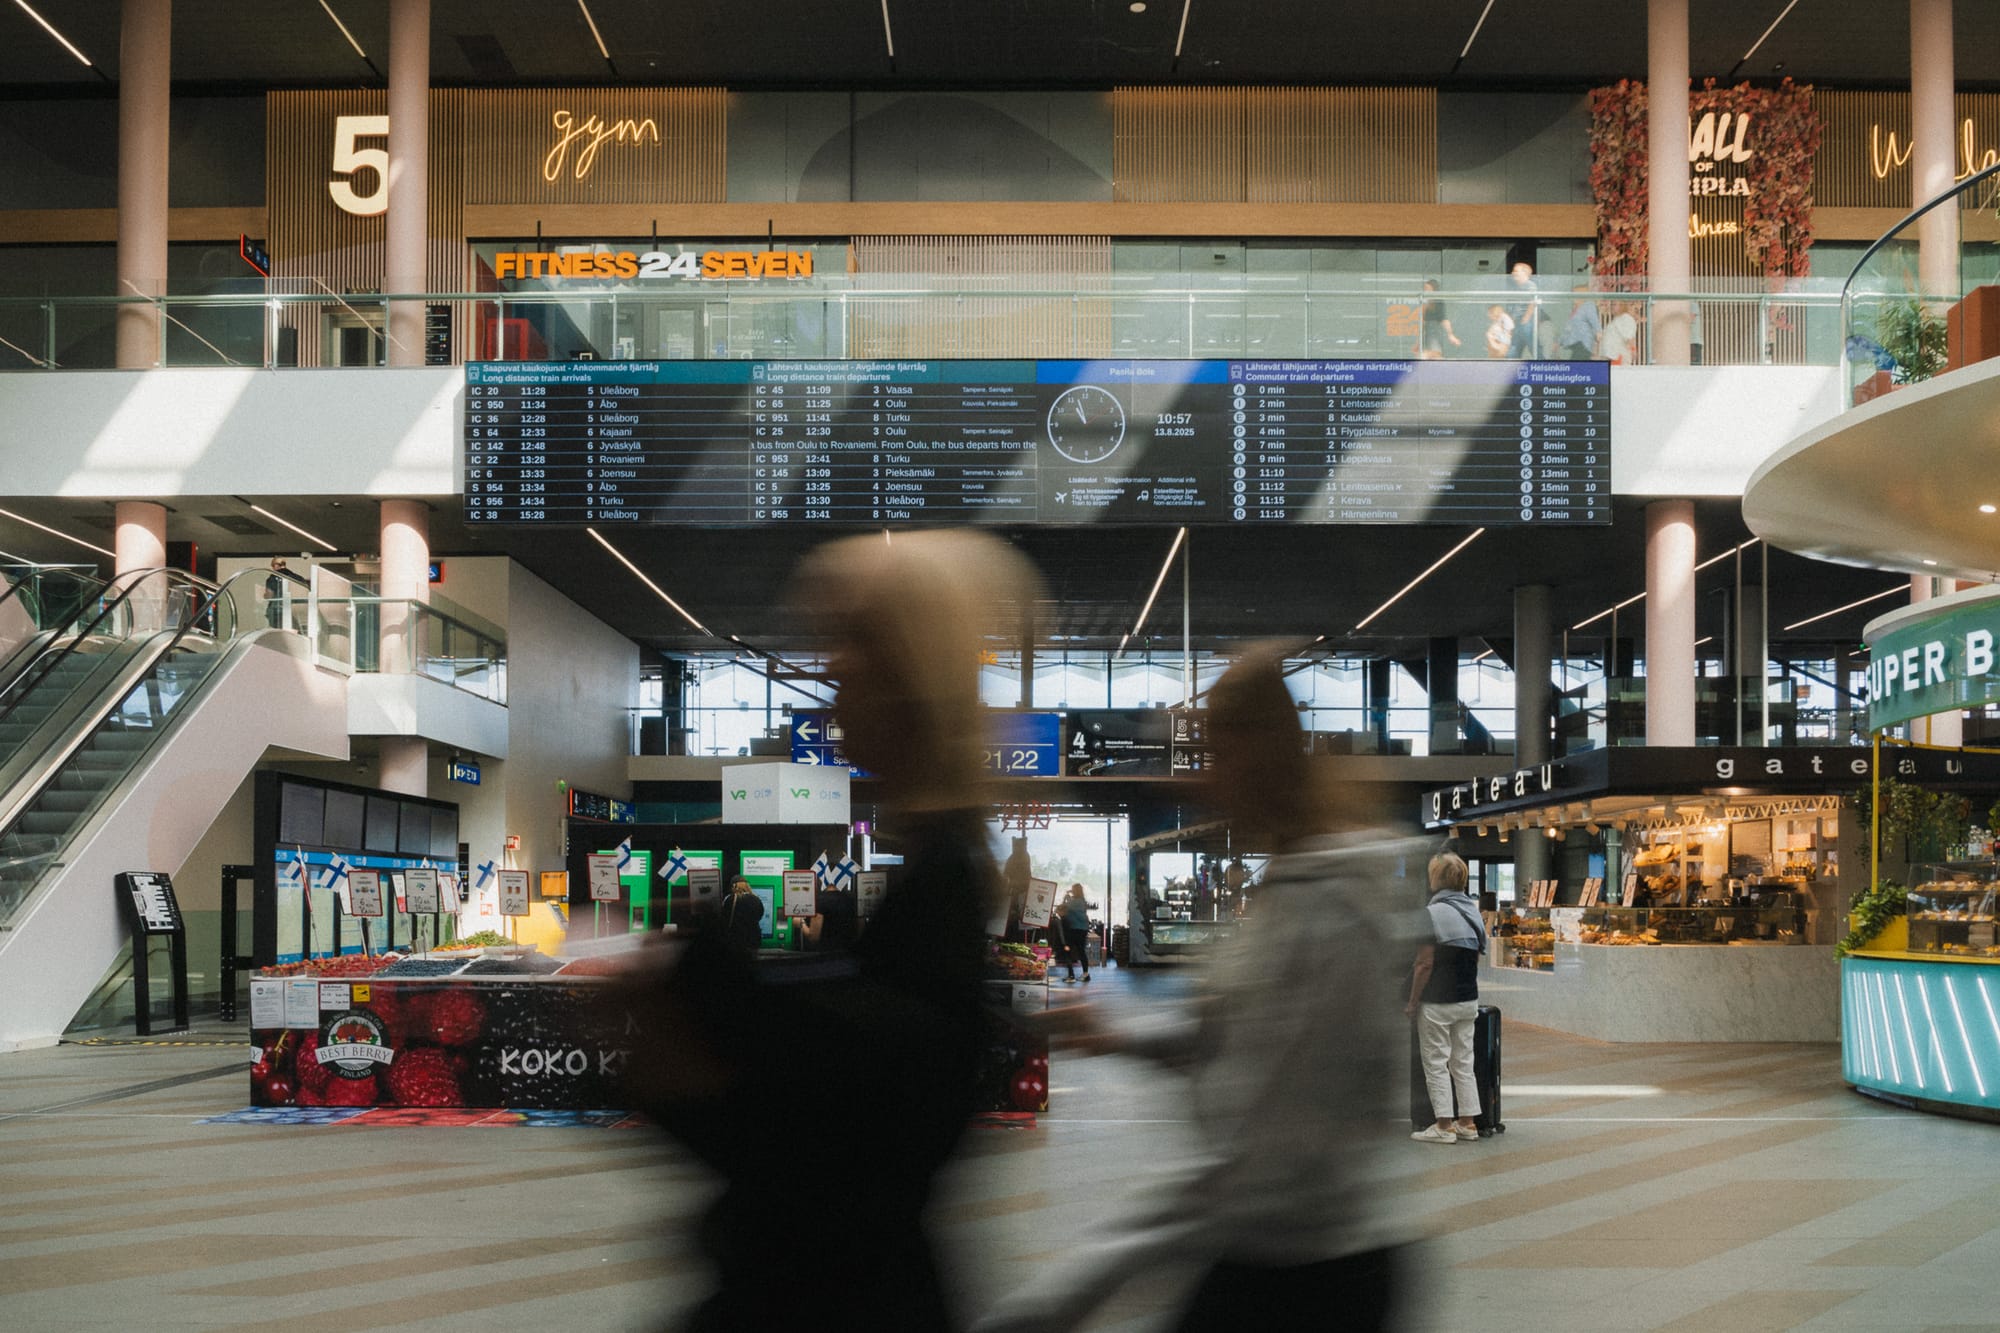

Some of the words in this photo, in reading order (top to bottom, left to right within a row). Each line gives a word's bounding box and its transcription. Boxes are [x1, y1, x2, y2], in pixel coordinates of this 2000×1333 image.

[1688, 111, 1753, 164] ALL
[545, 110, 659, 181] gym
[328, 115, 389, 217] 5
[1694, 162, 1715, 173] OF
[1688, 176, 1752, 197] IPLA
[483, 364, 520, 373] Saapuvat
[522, 363, 565, 373] kaukojunat
[573, 364, 627, 373] Ankommande
[630, 364, 659, 373] fjärrtåg
[804, 363, 848, 372] kaukojunat
[854, 362, 895, 374] Avgående
[898, 363, 926, 372] fjärrtåg
[1283, 363, 1317, 372] lähijunat
[1325, 363, 1364, 372] Avgående
[1366, 362, 1414, 374] närtrafiktåg
[483, 375, 503, 383] Long
[768, 374, 788, 382] Long
[846, 372, 890, 382] departures
[1545, 374, 1591, 382] Helsingfors
[488, 387, 498, 395] 20
[521, 387, 545, 395] 11:28
[600, 387, 639, 396] Uleåborg
[772, 386, 783, 394] 45
[806, 386, 831, 394] 11:09
[1326, 386, 1336, 394] 11
[1340, 387, 1392, 396] Leppävaara
[1585, 387, 1595, 395] 10
[600, 399, 618, 408] Åbo
[1544, 400, 1566, 408] 2min
[488, 415, 498, 423] 36
[600, 415, 638, 424] Uleåborg
[1156, 412, 1191, 424] 10:57
[600, 428, 632, 437] Kajaani
[772, 427, 783, 435] 25
[806, 427, 830, 435] 12:30
[886, 427, 906, 435] Oulu
[1326, 427, 1336, 435] 11
[1341, 427, 1391, 437] Flygplatsen
[1544, 428, 1566, 436] 5min
[1585, 428, 1595, 436] 10
[488, 442, 503, 450] 142
[521, 442, 545, 450] 12:48
[600, 442, 641, 451] Jyväskylä
[775, 441, 794, 449] from
[797, 441, 817, 449] Oulu
[831, 441, 878, 449] Rovaniemi.
[906, 441, 929, 450] Oulu,
[967, 441, 1000, 450] departs
[1023, 441, 1038, 450] the
[1342, 440, 1373, 450] Kerava
[487, 456, 498, 464] 22
[521, 456, 545, 464] 13:28
[772, 455, 788, 463] 953
[1326, 455, 1337, 463] 11
[521, 470, 544, 478] 13:33
[772, 469, 788, 477] 145
[806, 469, 830, 477] 13:09
[1260, 469, 1284, 477] 11:10
[600, 482, 617, 491] Åbo
[1542, 483, 1569, 491] 15min
[886, 496, 926, 506] Uleåborg
[1260, 496, 1284, 504] 11:15
[1542, 497, 1569, 505] 16min
[487, 511, 497, 519] 38
[520, 511, 544, 519] 15:28
[600, 511, 638, 520] Uleåborg
[772, 510, 788, 518] 955
[806, 510, 830, 518] 13:41
[885, 510, 909, 518] Turku
[1260, 510, 1284, 518] 11:15
[1865, 640, 1946, 706] SUPER
[1072, 731, 1086, 750] 4
[730, 789, 747, 800] VR
[790, 788, 811, 799] VR
[1432, 763, 1552, 821] gateau
[320, 1045, 347, 1062] BEST
[352, 1045, 391, 1063] BERRY
[499, 1048, 588, 1076] KOKO
[339, 1068, 373, 1079] FINLAND
